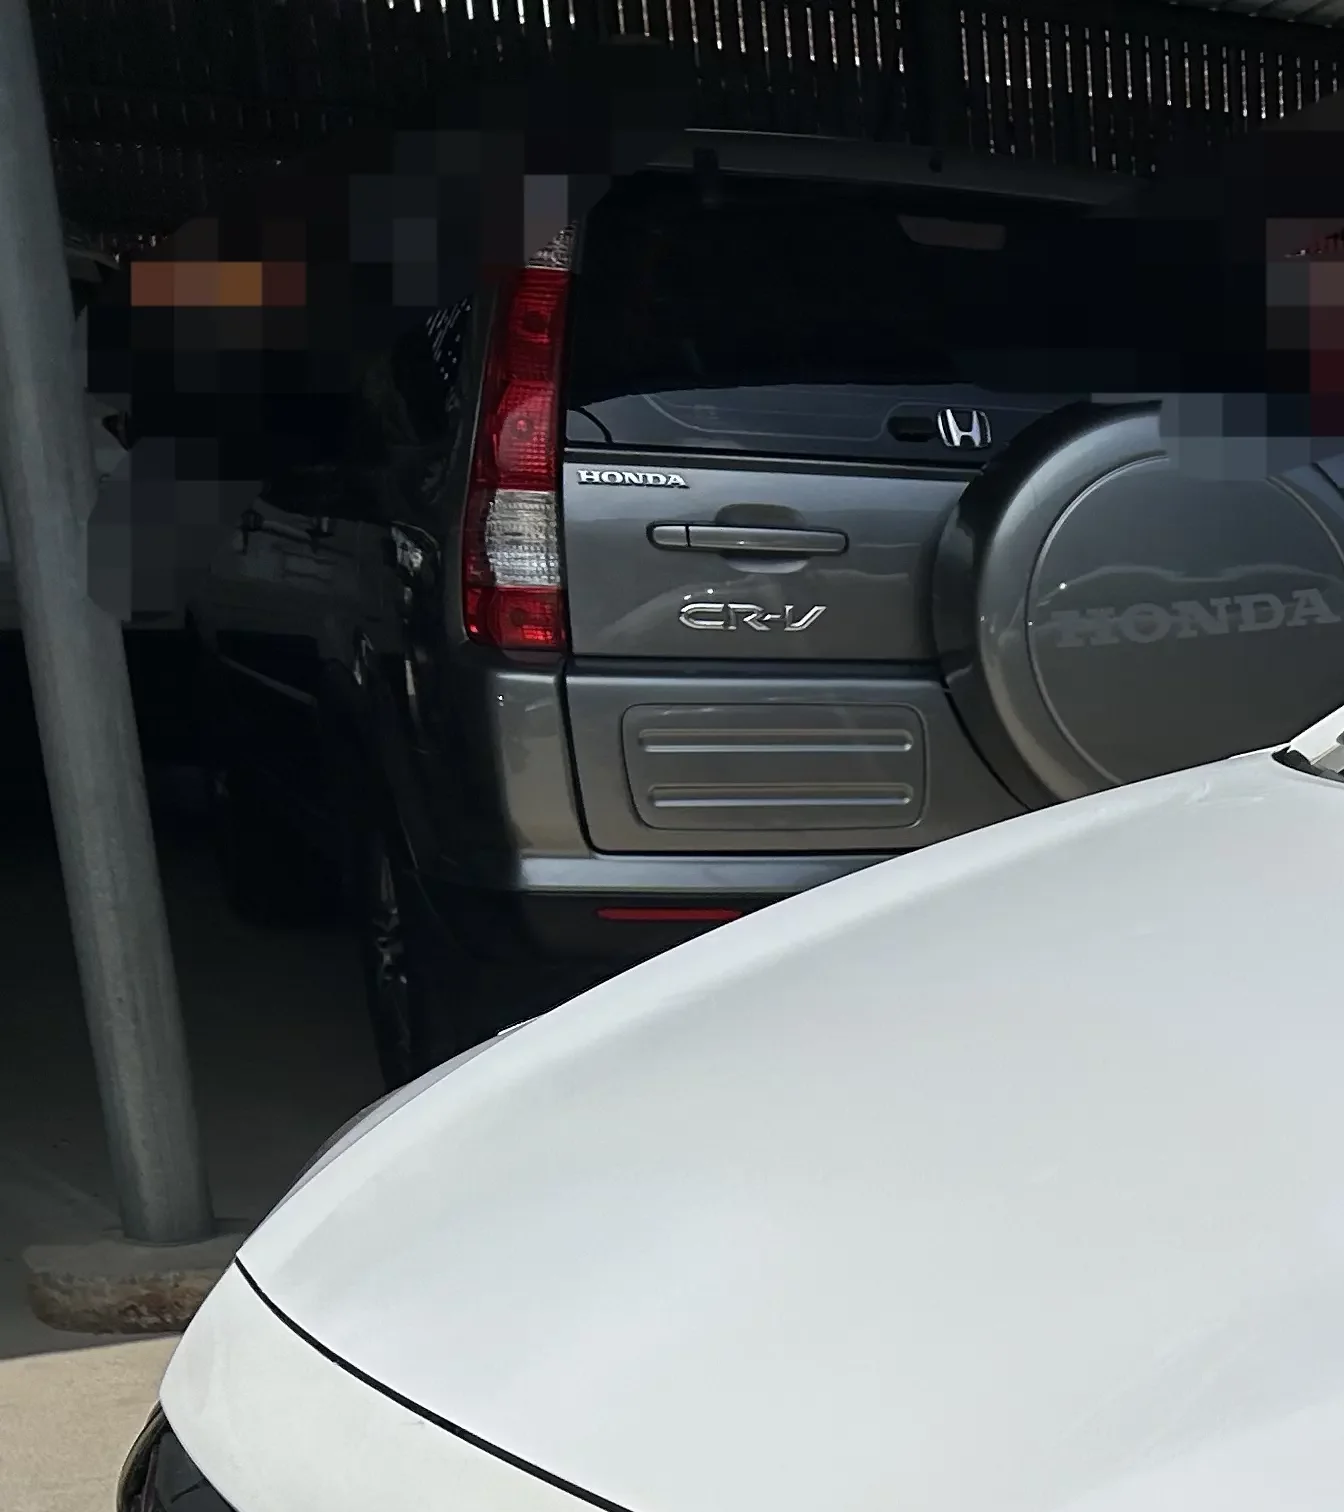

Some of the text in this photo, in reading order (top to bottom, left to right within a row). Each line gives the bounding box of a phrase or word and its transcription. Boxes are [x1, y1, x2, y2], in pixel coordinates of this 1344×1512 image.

[577, 469, 690, 489] HONDA
[679, 602, 828, 632] CR-V
[1050, 587, 1342, 649] HONDA
